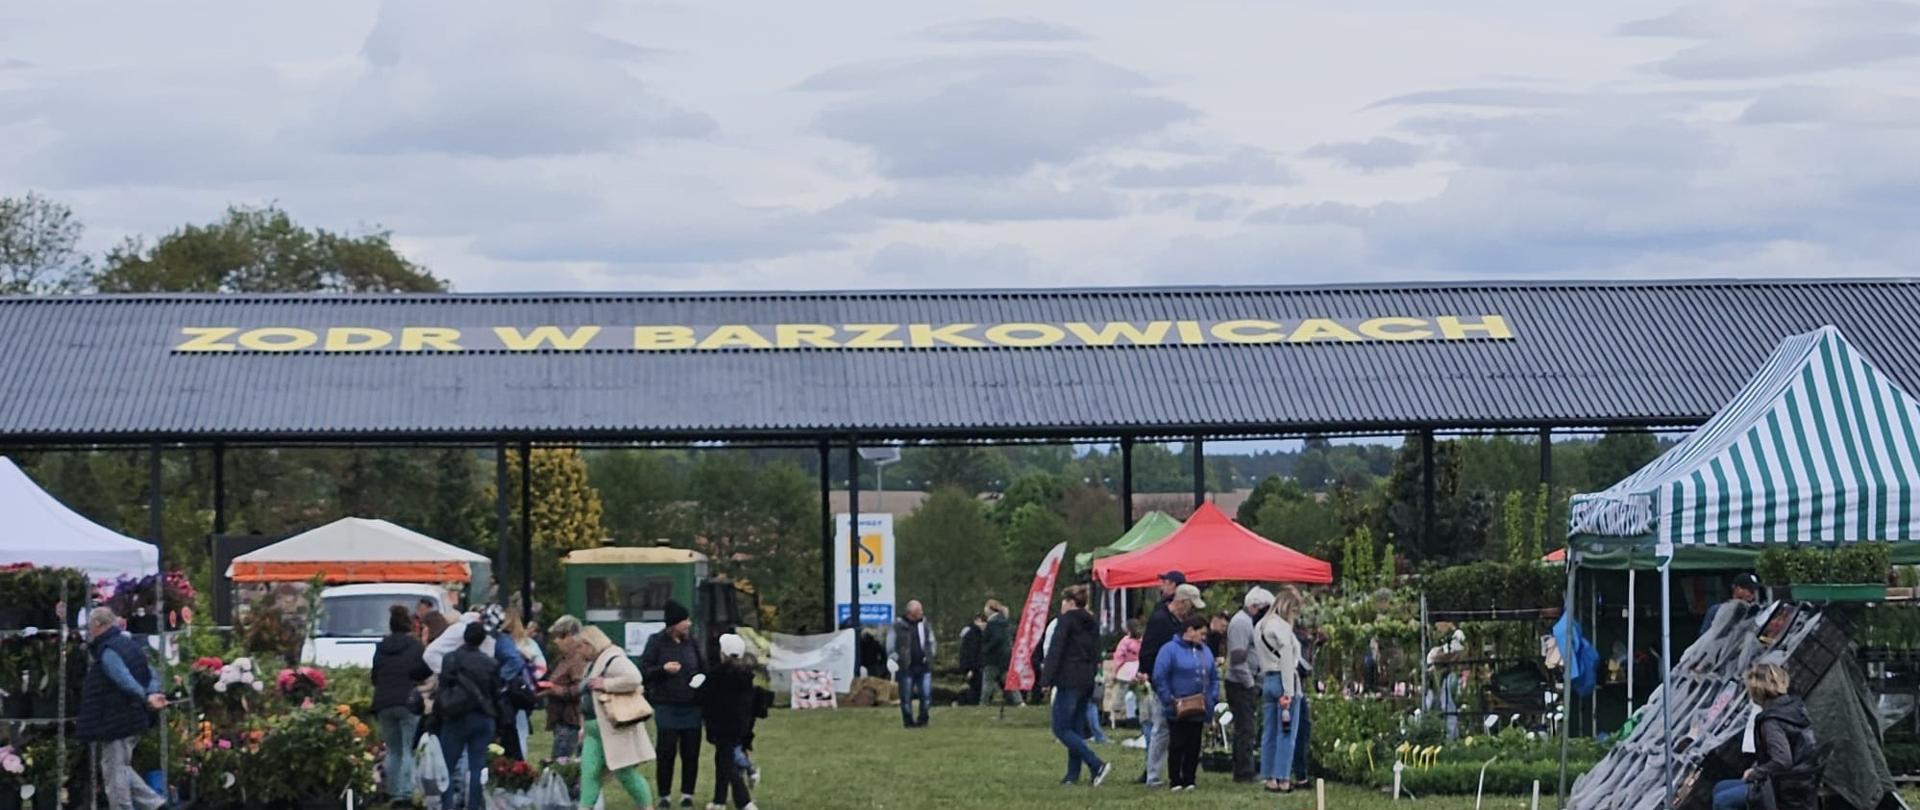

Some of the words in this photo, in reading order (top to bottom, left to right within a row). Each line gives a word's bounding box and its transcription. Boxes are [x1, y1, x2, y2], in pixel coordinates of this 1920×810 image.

[176, 327, 463, 350] ZODR
[493, 326, 601, 350] W
[635, 315, 1512, 349] BARZKOWICACH
